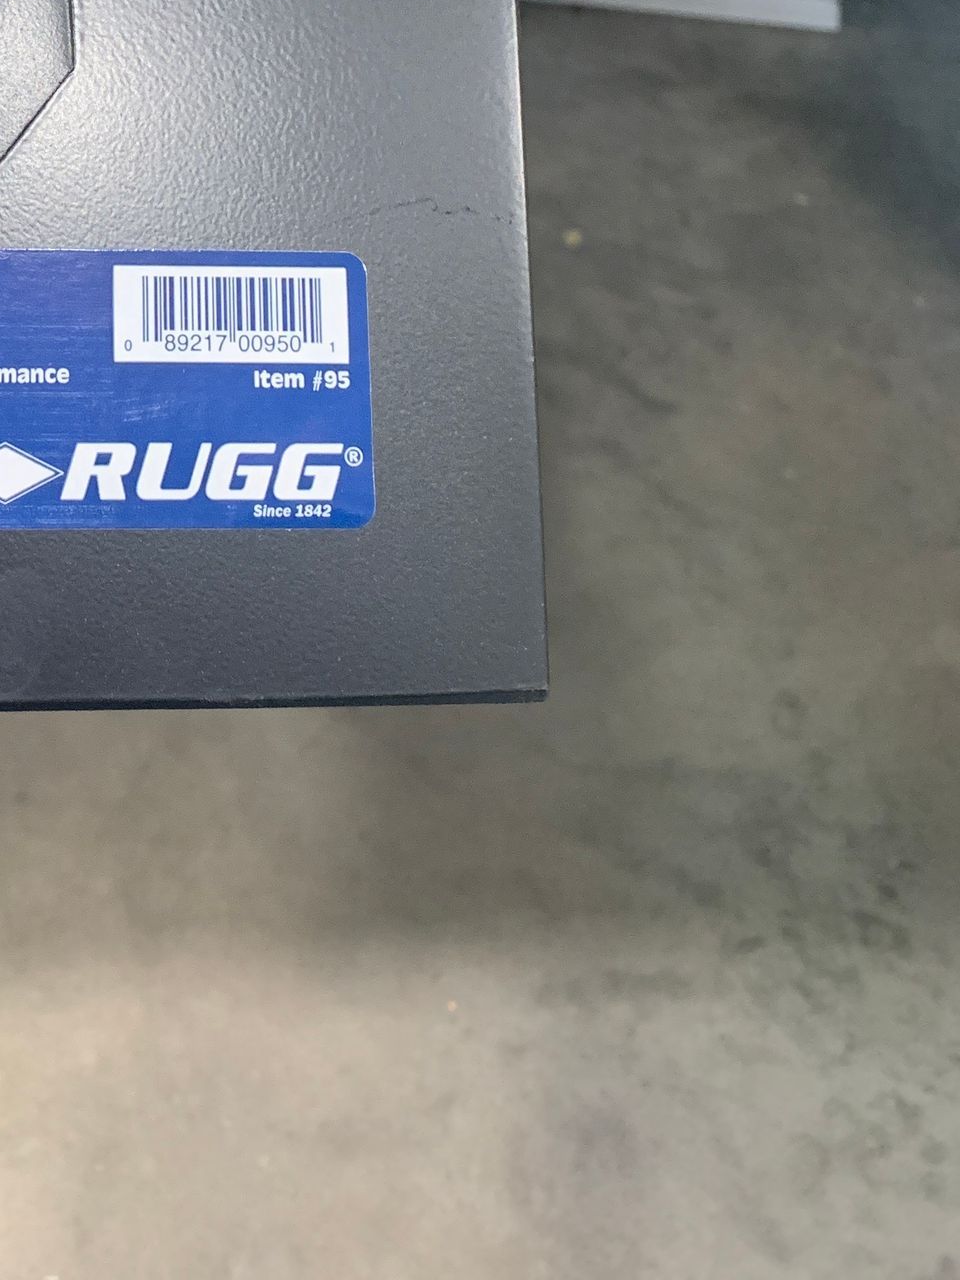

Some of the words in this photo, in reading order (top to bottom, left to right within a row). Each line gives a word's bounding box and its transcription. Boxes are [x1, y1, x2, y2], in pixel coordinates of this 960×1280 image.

[124, 339, 133, 352] 0
[164, 334, 227, 352] 89217
[238, 334, 302, 353] 00950
[329, 342, 336, 352] 1
[253, 370, 305, 389] Item
[313, 370, 351, 391] #95
[253, 504, 292, 518] Since
[295, 504, 332, 518] 1842
